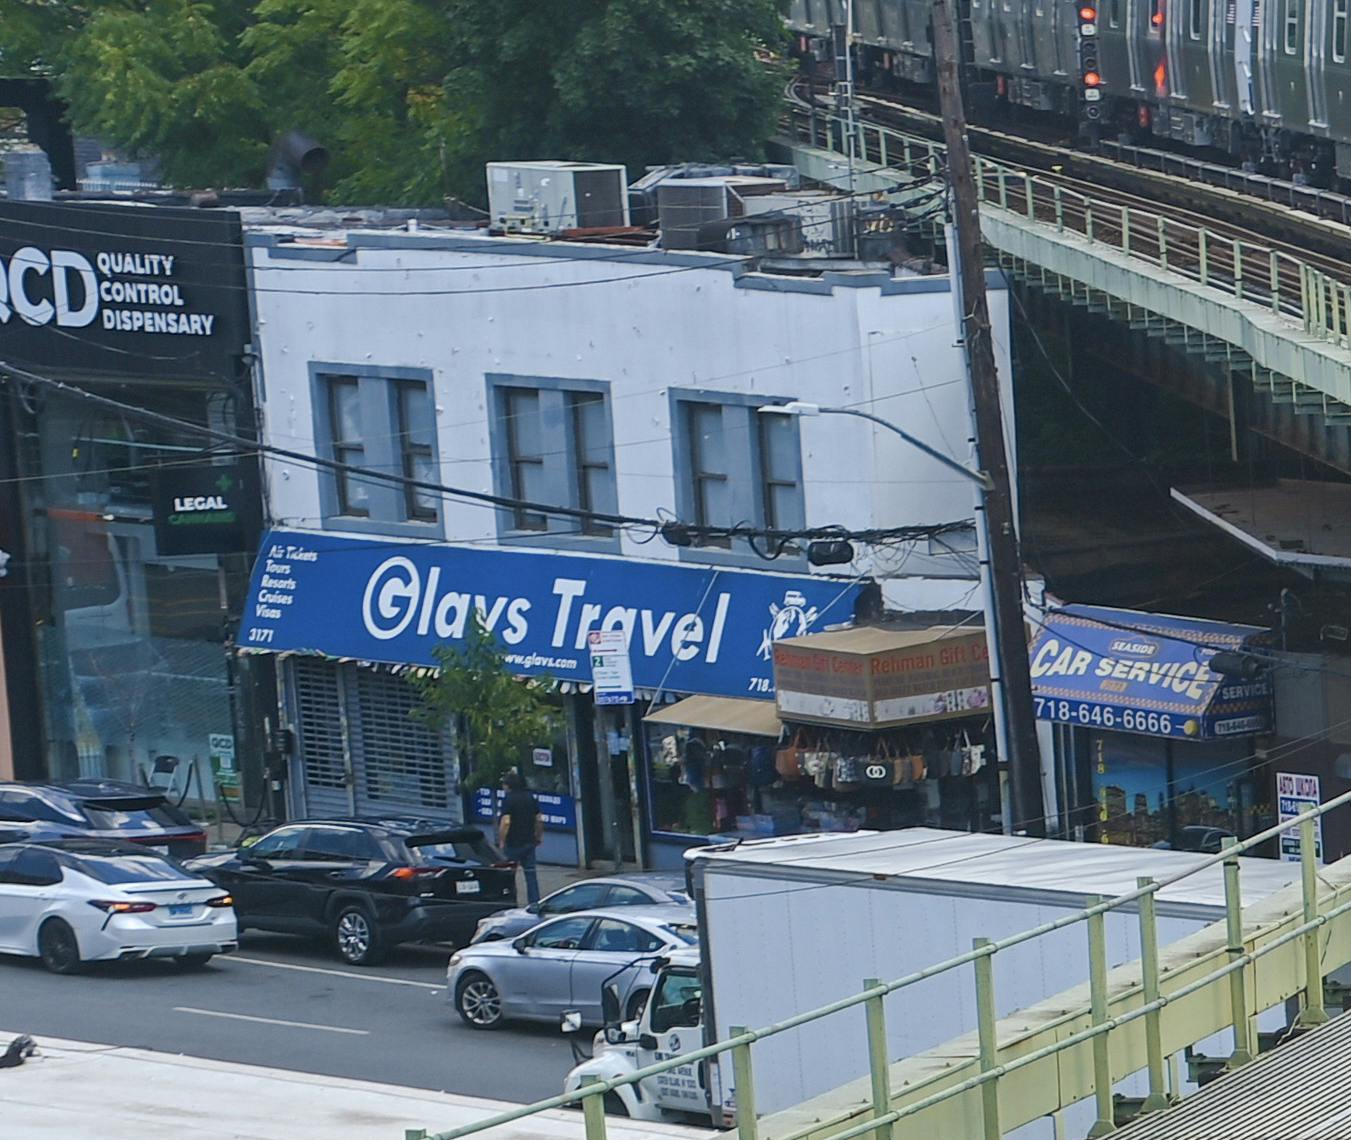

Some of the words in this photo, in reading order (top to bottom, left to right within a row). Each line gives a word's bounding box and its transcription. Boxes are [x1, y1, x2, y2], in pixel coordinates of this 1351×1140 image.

[97, 252, 174, 278] QUALITY
[100, 281, 184, 305] CONTROL
[102, 308, 214, 335] DISPENSARY
[174, 496, 228, 512] LEGAL
[269, 545, 285, 559] Air
[286, 545, 318, 562] Tickets
[265, 559, 291, 574] Tours
[261, 574, 297, 590] Resorts
[258, 589, 293, 605] Cruises
[255, 603, 282, 619] Visas
[551, 577, 730, 664] Travel
[248, 628, 274, 643] 3171
[1111, 640, 1156, 655] SEASIDE
[501, 651, 577, 670] ww.glavs.com
[871, 651, 934, 675] Rehman
[939, 646, 965, 666] Gift
[1030, 638, 1092, 678] CAR
[1094, 656, 1210, 701] SERVICE
[1034, 697, 1172, 735] 718-646-6666
